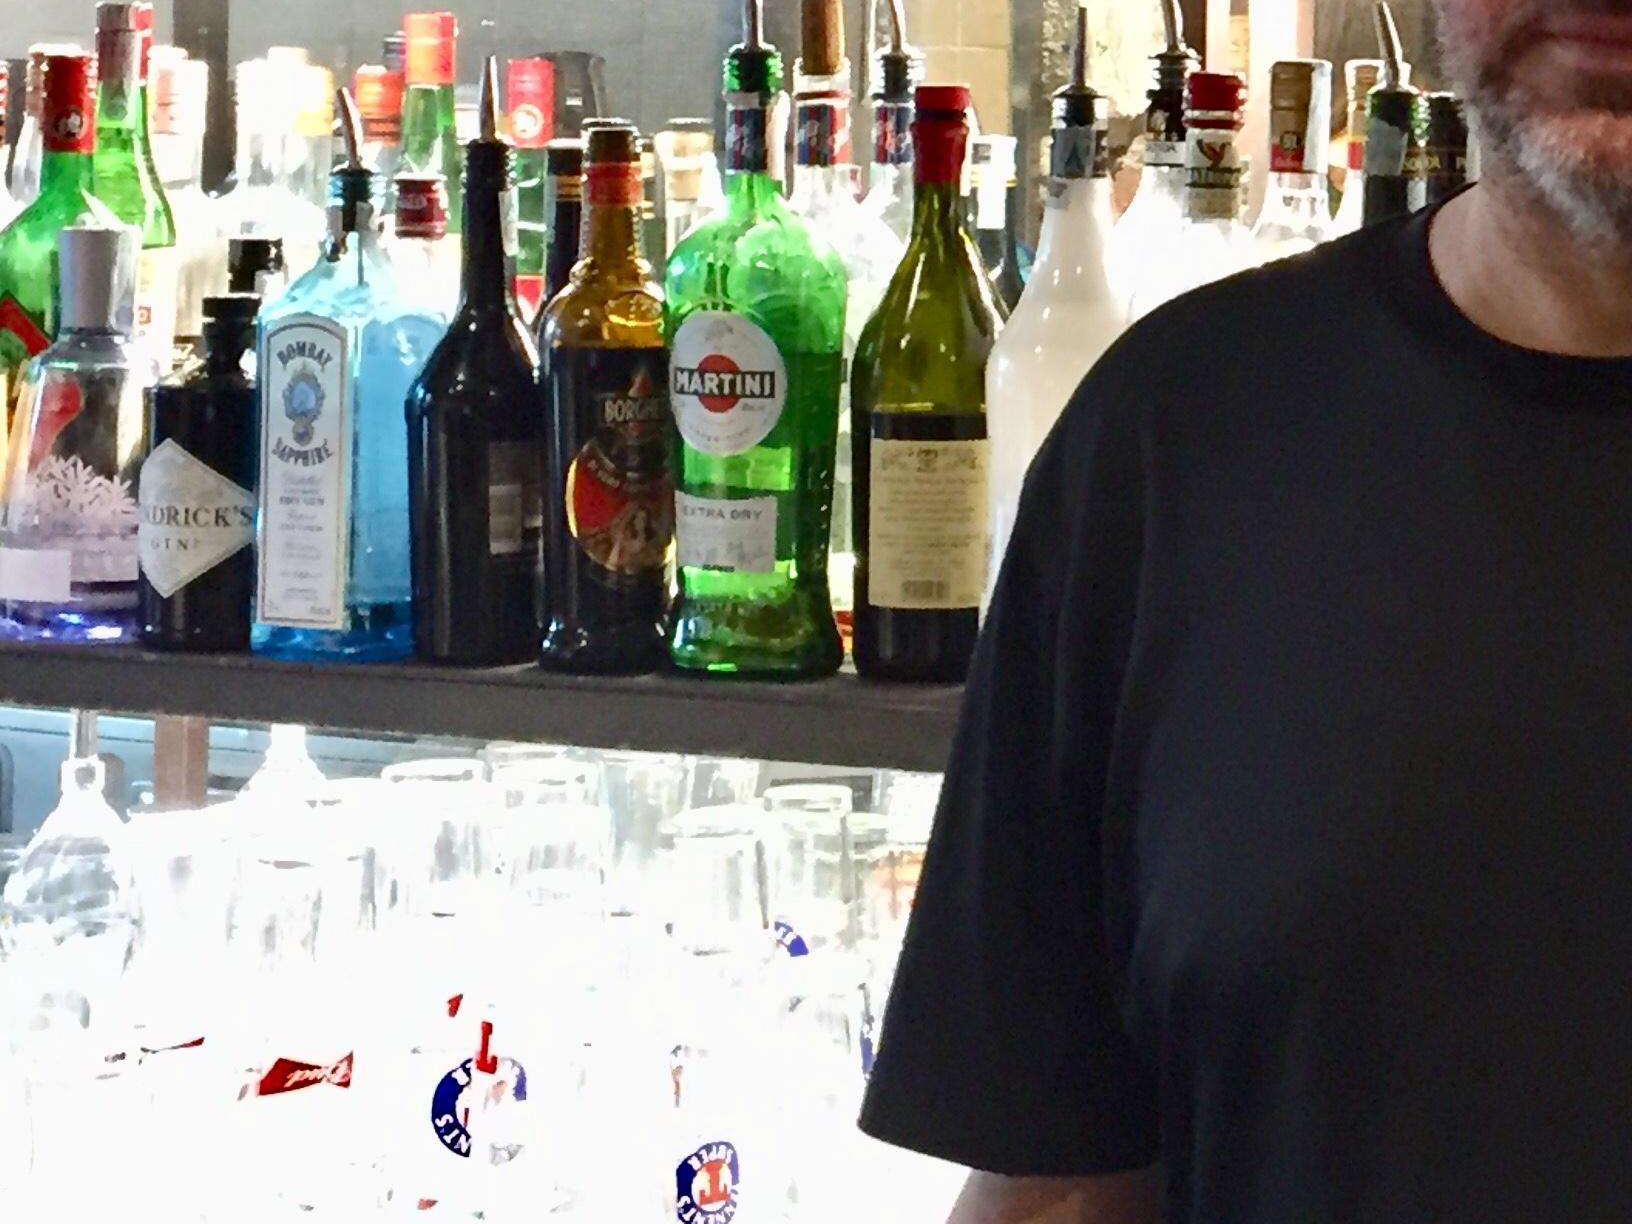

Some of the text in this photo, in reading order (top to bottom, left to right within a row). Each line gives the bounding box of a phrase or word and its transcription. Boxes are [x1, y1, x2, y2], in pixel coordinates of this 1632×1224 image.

[276, 340, 334, 372] BOMBAY
[675, 370, 771, 397] MARTINI
[272, 435, 336, 468] SAPPHIRE
[682, 505, 764, 520] EXTRA DRY
[150, 536, 189, 551] GIN
